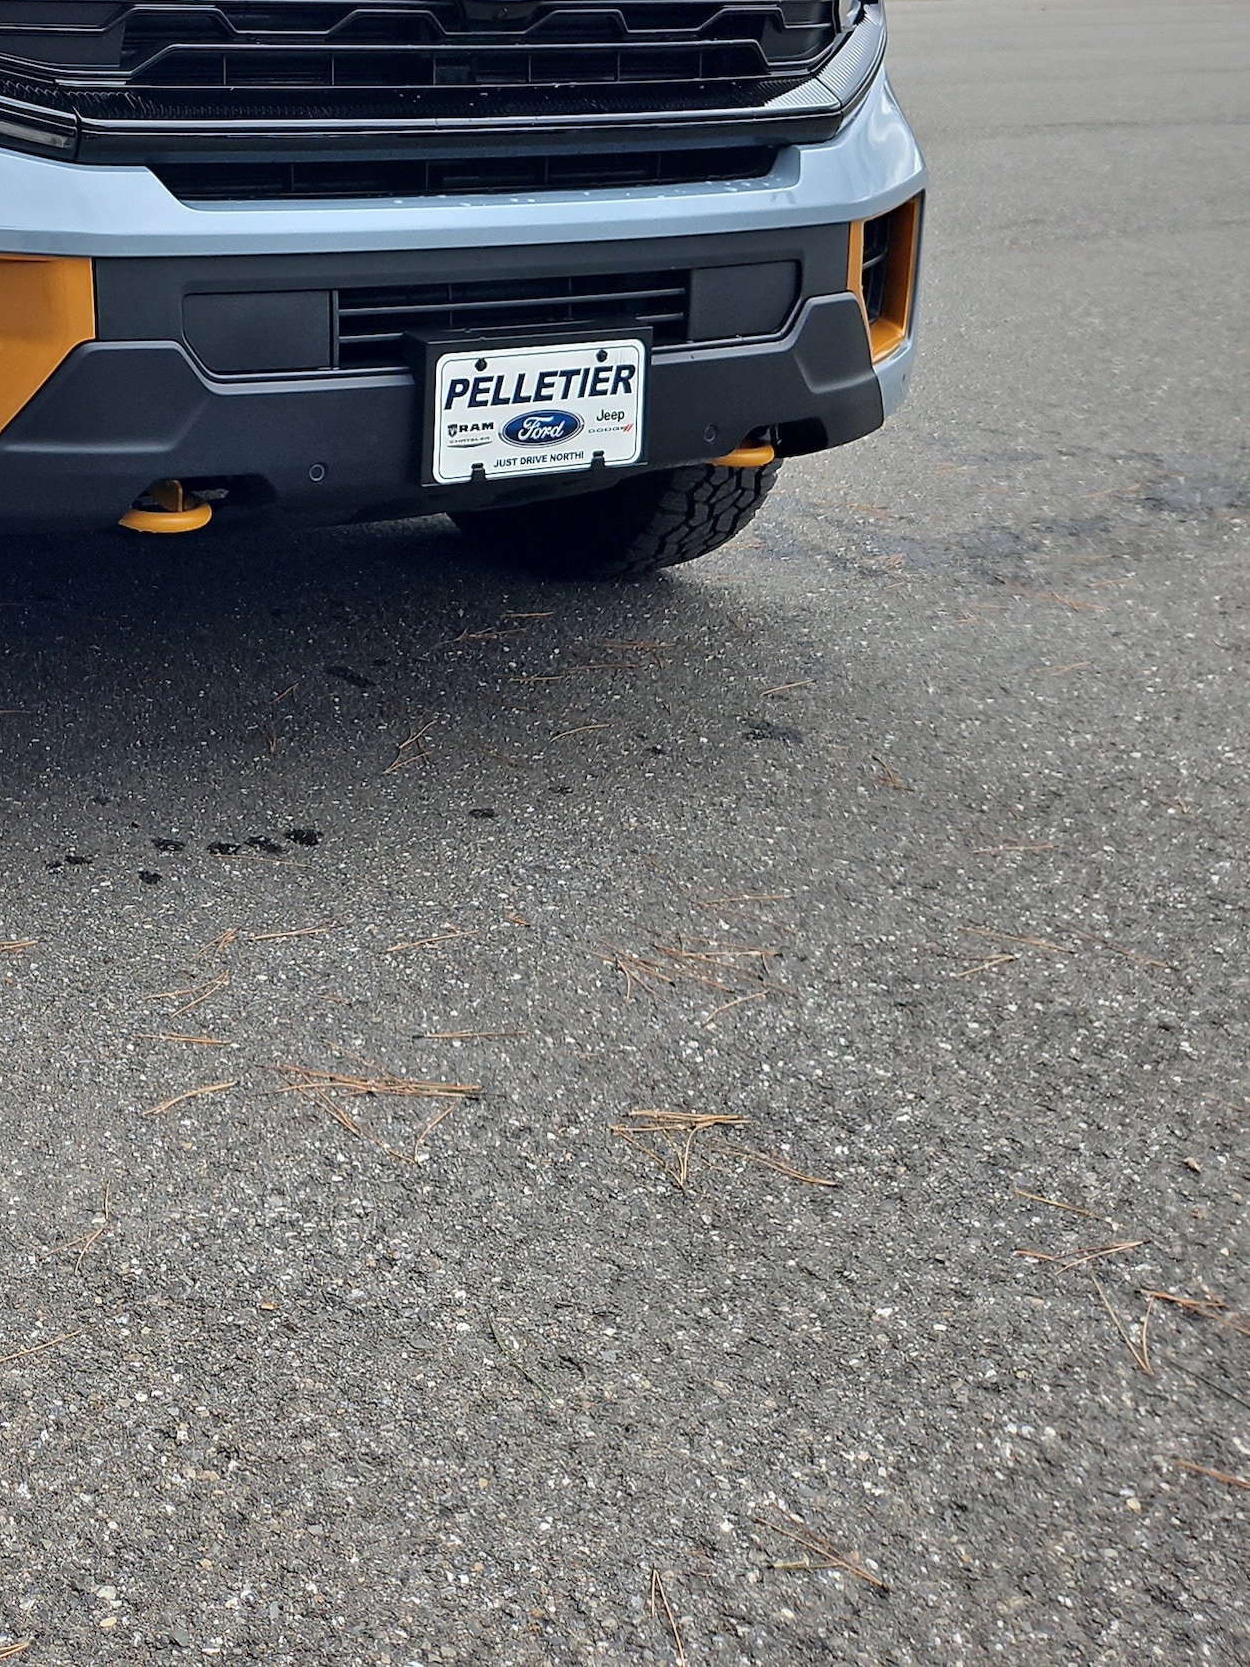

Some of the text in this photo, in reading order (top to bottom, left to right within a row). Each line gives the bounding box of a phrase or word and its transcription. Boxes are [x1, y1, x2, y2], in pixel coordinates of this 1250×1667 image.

[444, 364, 636, 410] PELLETIER
[596, 409, 625, 422] Jeep
[459, 422, 494, 433] RAM
[518, 416, 565, 441] Ford
[588, 426, 626, 434] DODGE
[450, 436, 490, 444] CHRYSLER
[493, 451, 584, 468] JUST DRIVE NORTH!
